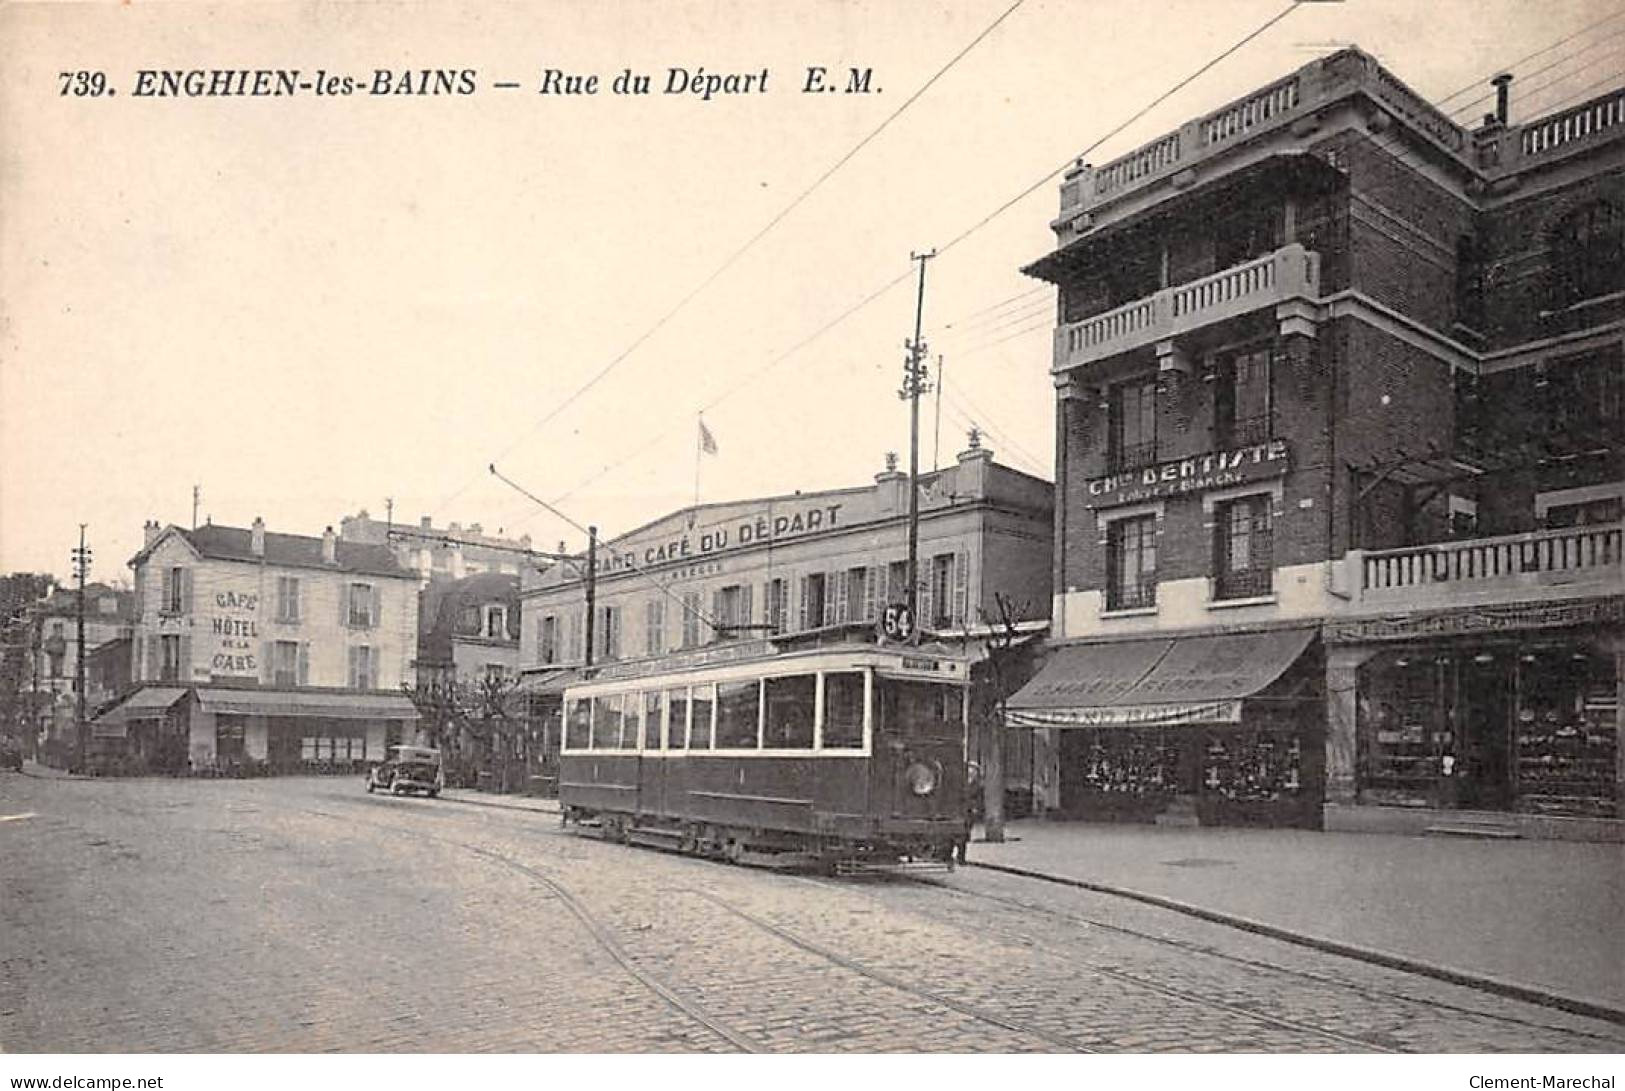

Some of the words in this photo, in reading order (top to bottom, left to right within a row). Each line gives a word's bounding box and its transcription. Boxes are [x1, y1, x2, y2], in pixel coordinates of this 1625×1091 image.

[644, 535, 691, 565] CAFÉ
[701, 524, 728, 550] DU
[739, 503, 843, 543] DÉPART
[215, 590, 259, 611] CAFÉ
[212, 615, 259, 637] HÔTEL
[884, 607, 909, 637] 54
